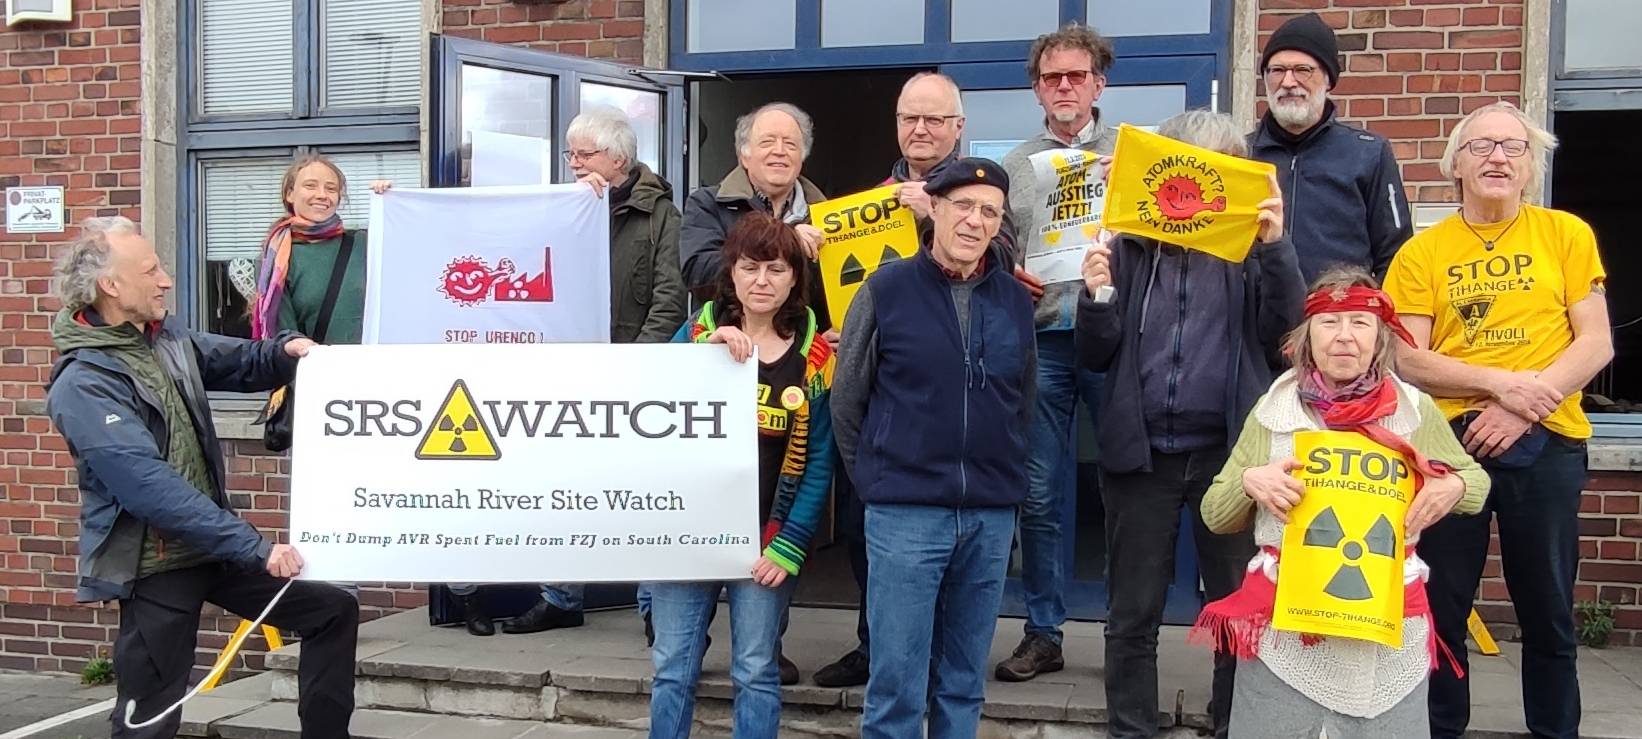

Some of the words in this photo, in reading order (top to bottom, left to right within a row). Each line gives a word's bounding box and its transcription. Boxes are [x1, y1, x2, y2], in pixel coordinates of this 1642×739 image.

[1056, 168, 1092, 190] ATOM-
[1142, 154, 1225, 194] ATOMKRAFT?
[1046, 182, 1104, 208] AUSSTIEG
[823, 197, 901, 234] STOP
[1052, 202, 1092, 221] JETZT!
[825, 220, 905, 244] TIHANGE&DOEL
[1162, 215, 1215, 235] DANKE
[1447, 254, 1533, 286] STOP
[1448, 280, 1517, 298] TIHANGE
[445, 330, 478, 343] STOP
[485, 331, 536, 344] URENCO
[1482, 328, 1525, 341] TIVOLI
[324, 400, 423, 437] SRS
[483, 400, 728, 439] WATCH
[1305, 446, 1409, 485] STOP
[353, 487, 472, 511] Savannah
[477, 488, 543, 511] River
[550, 489, 599, 511] Site
[602, 489, 685, 512] Watch
[299, 531, 342, 543] Don't
[346, 532, 393, 547] Dump
[396, 533, 430, 545] AVR
[435, 533, 480, 548] Spent
[484, 534, 520, 546] Fuel
[524, 534, 564, 546] from
[568, 534, 597, 548] FZJ
[602, 537, 621, 546] on
[626, 534, 672, 546] South
[678, 533, 750, 546] Carolina
